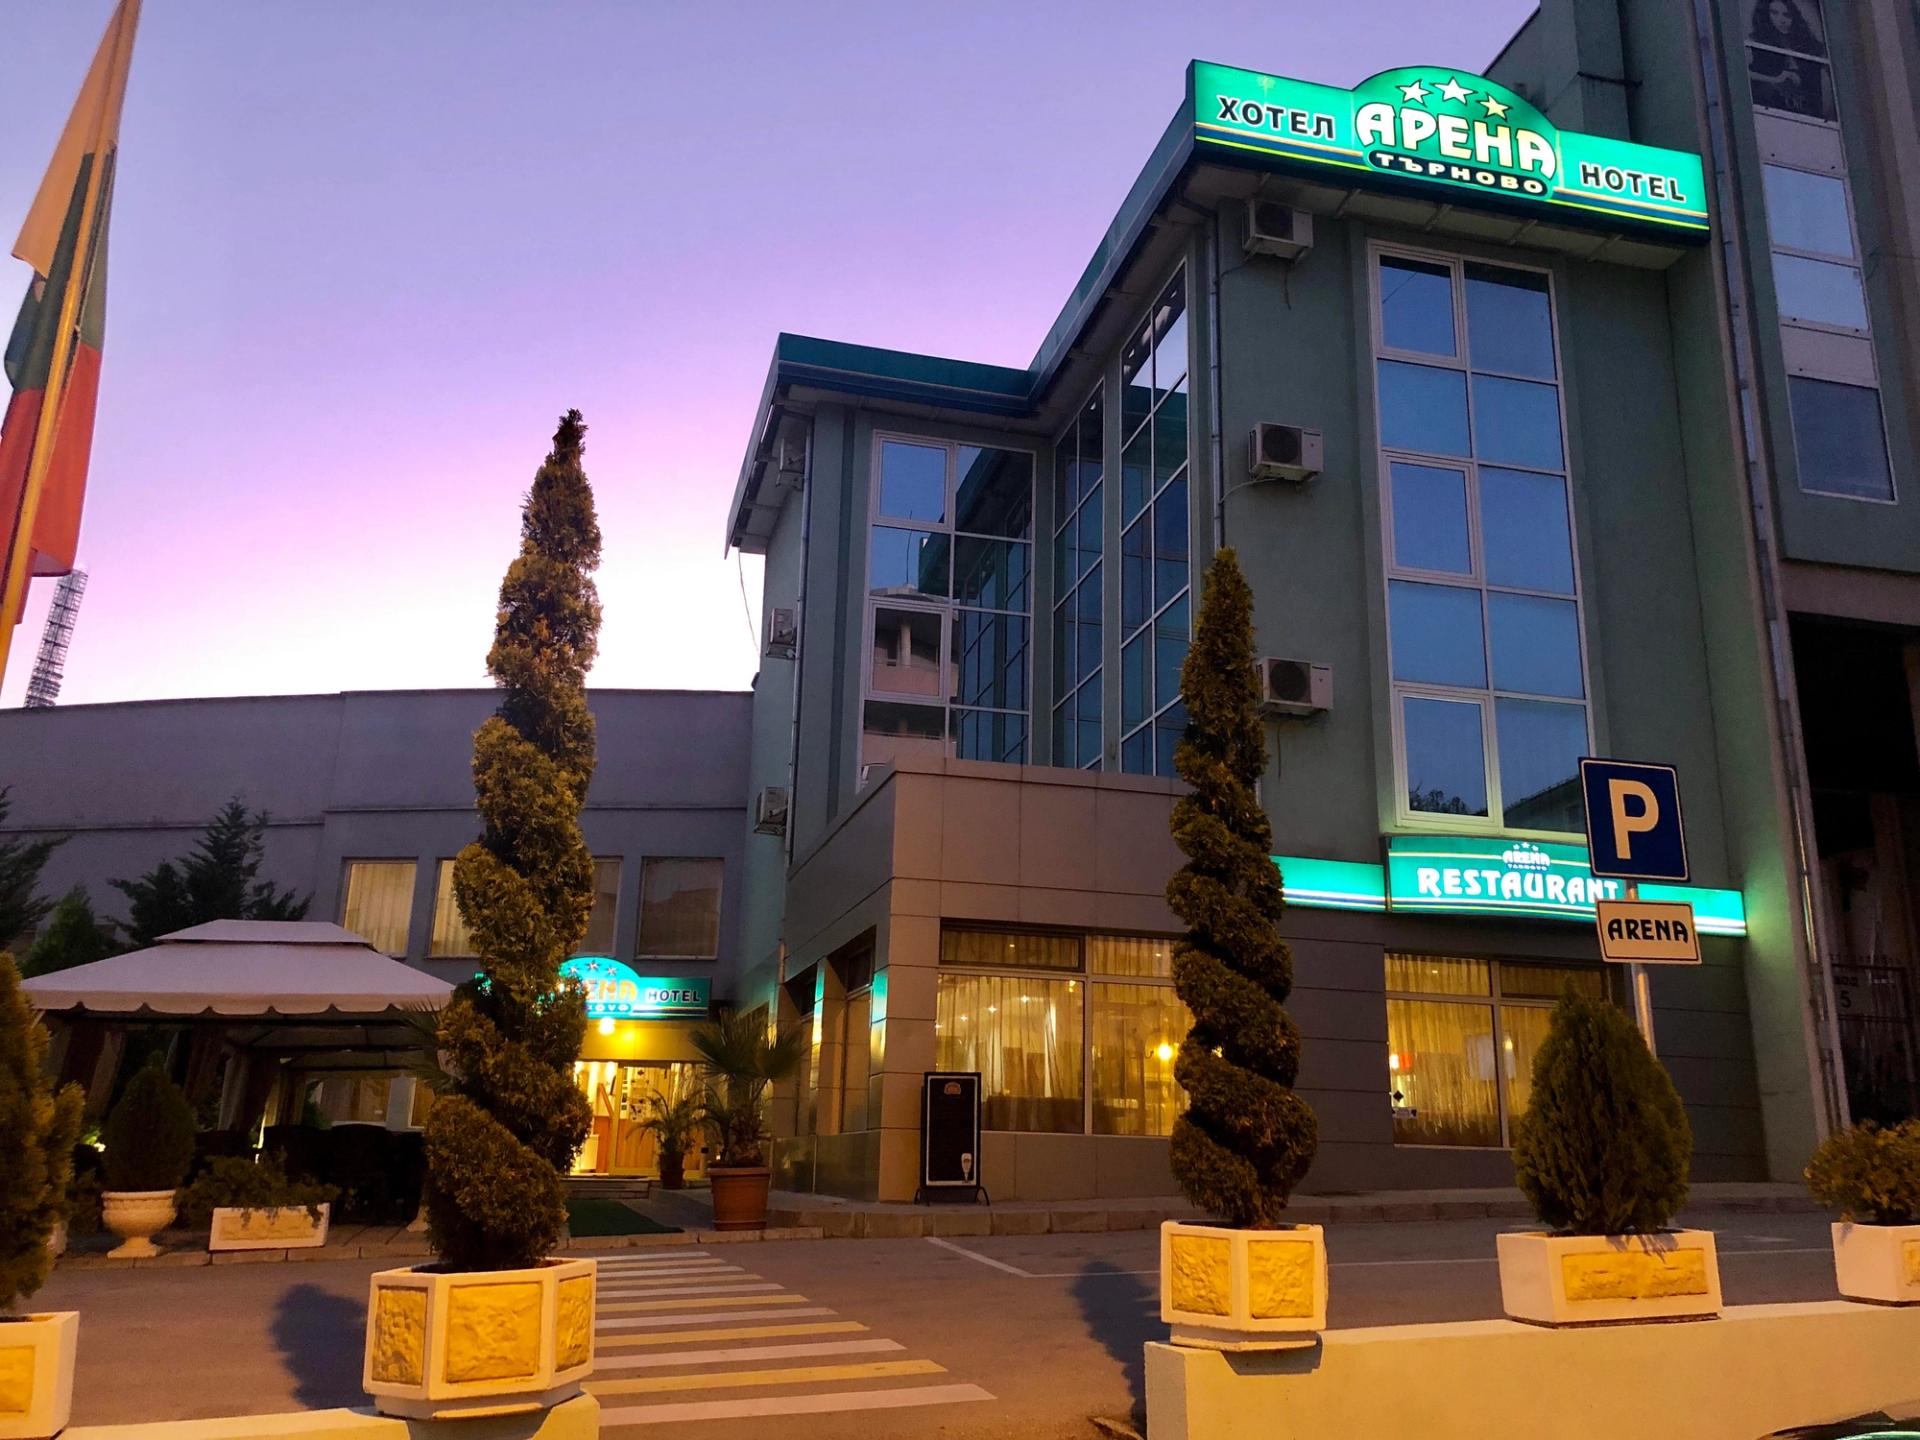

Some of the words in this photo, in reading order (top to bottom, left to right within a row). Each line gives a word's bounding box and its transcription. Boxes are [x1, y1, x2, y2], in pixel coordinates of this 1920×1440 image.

[1217, 95, 1336, 140] ХОТЕЛ
[1355, 102, 1557, 180] АРЕНА
[1375, 152, 1543, 194] ТЪРНОВО
[1580, 163, 1686, 203] HOTEL
[1608, 778, 1660, 860] P
[1417, 867, 1619, 904] RESTAURANT
[1607, 918, 1689, 944] ARENA
[646, 988, 702, 1003] HOTEL
